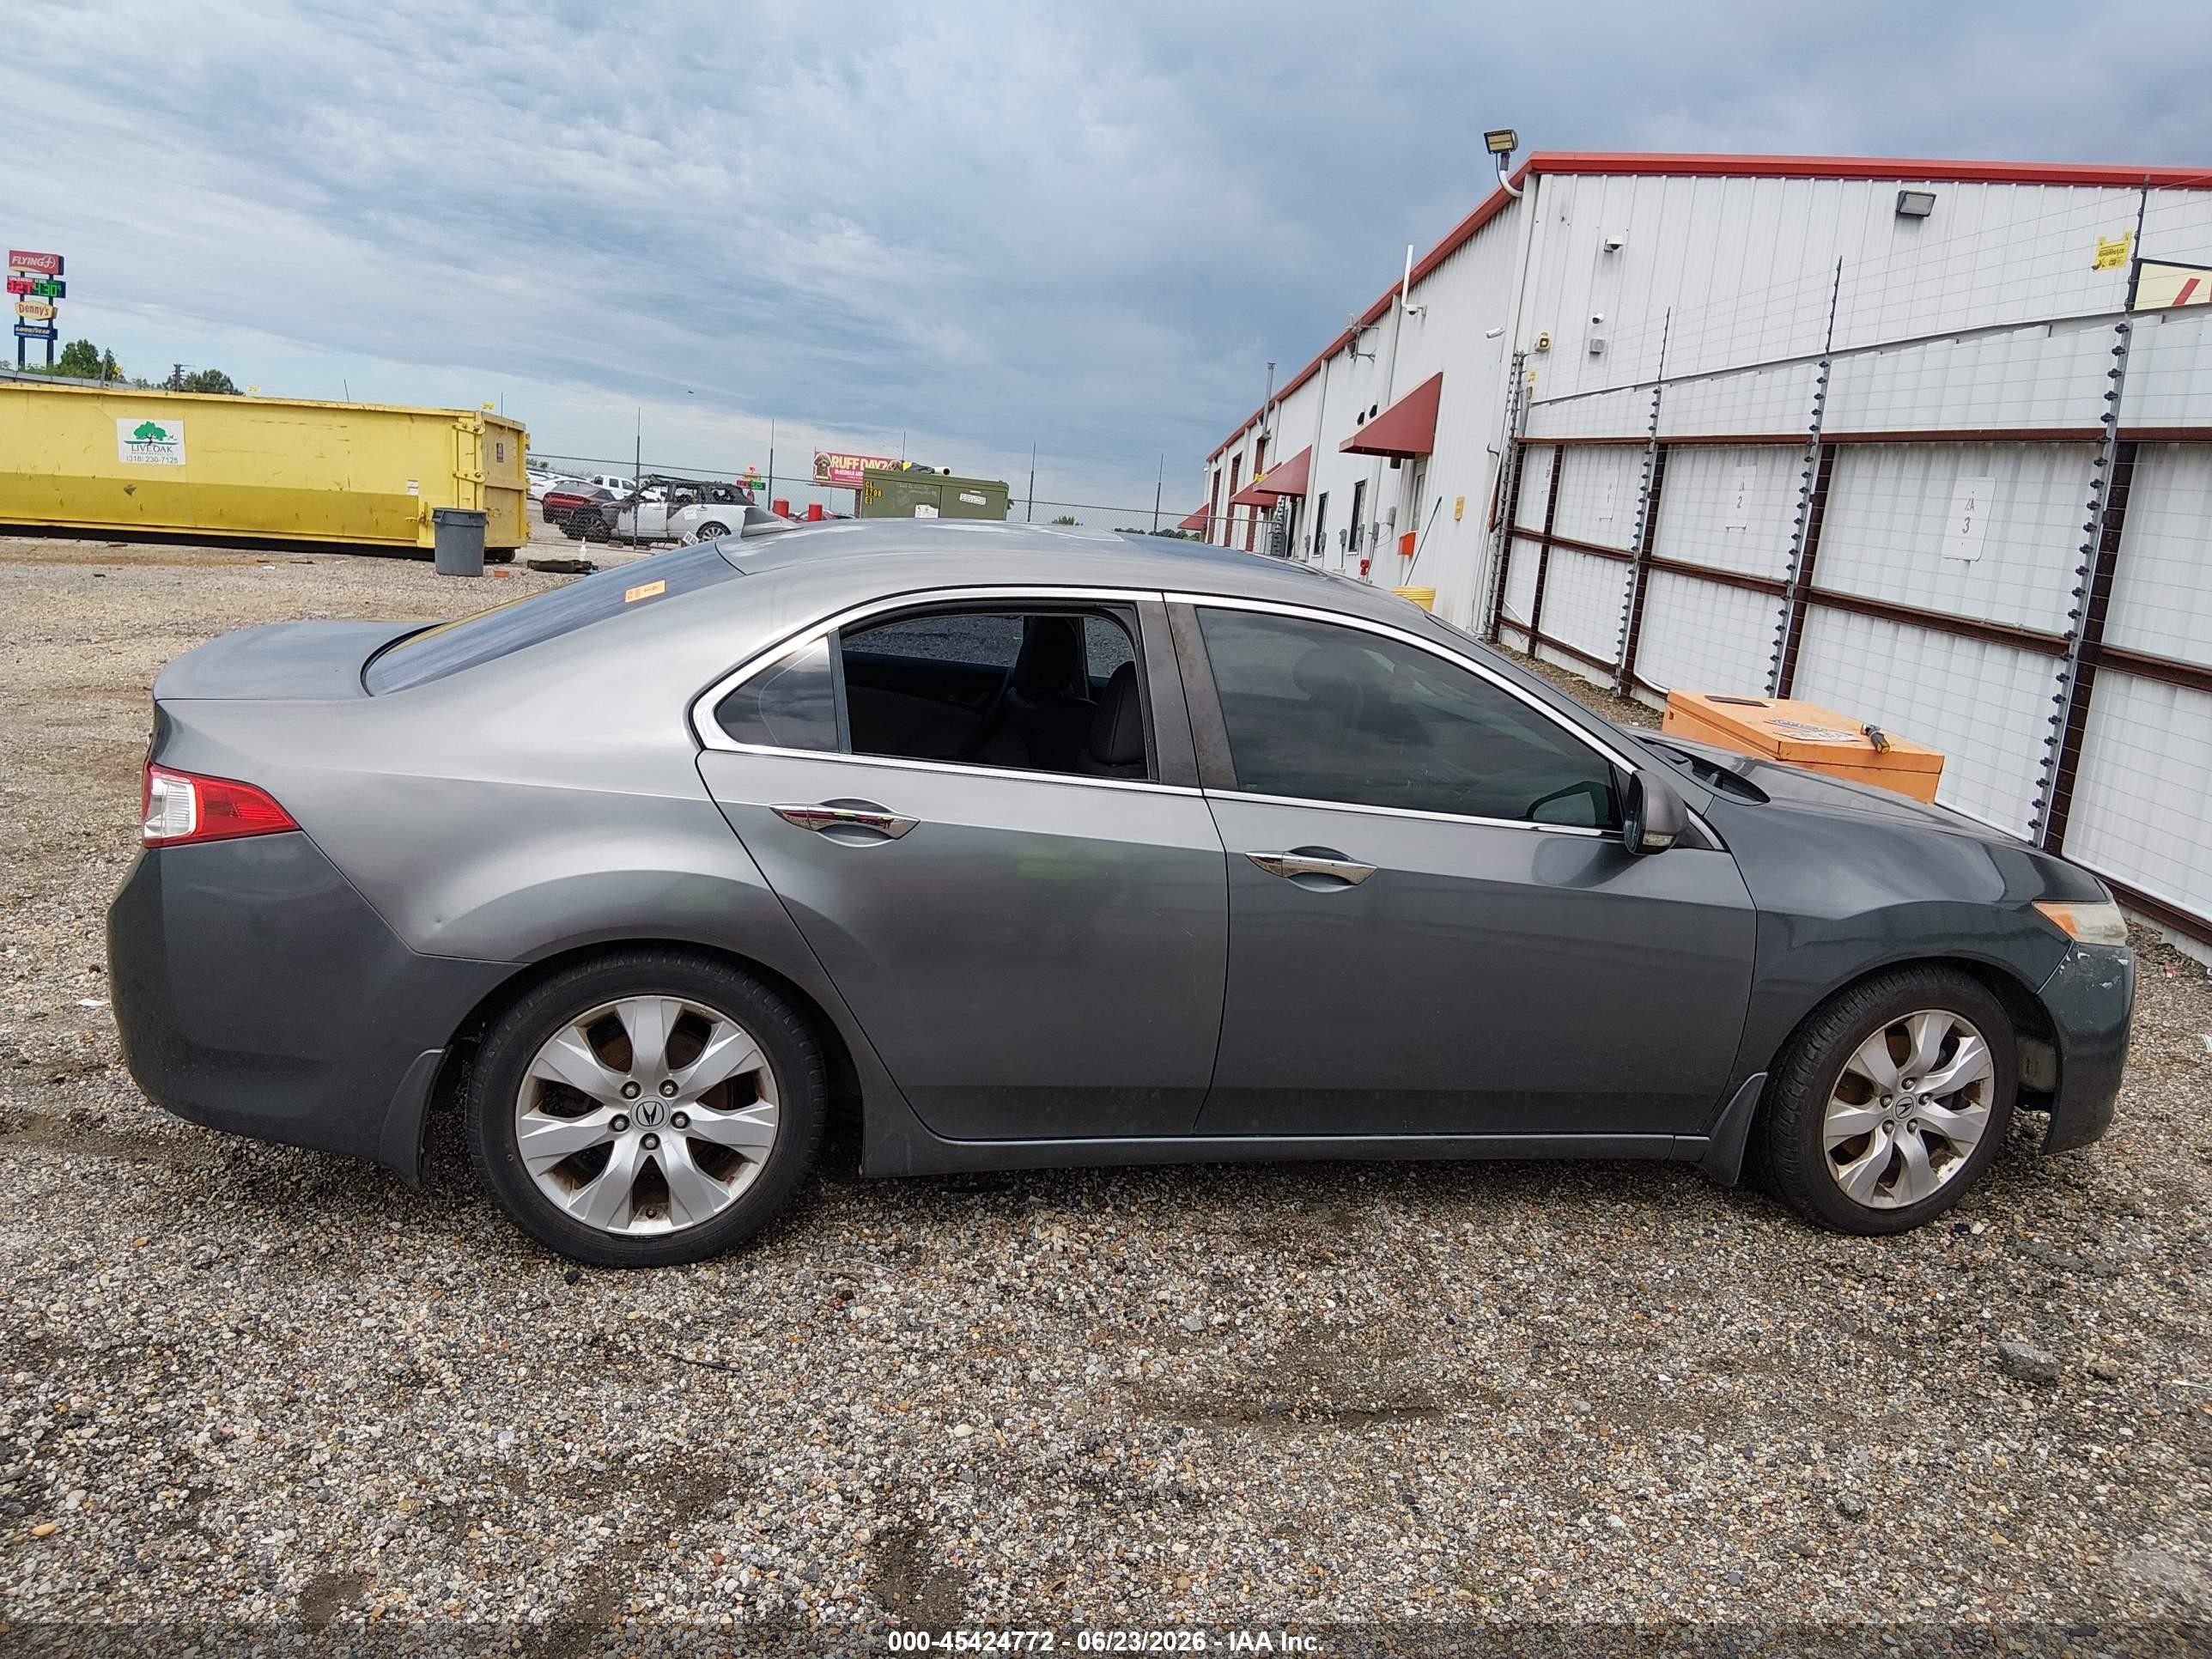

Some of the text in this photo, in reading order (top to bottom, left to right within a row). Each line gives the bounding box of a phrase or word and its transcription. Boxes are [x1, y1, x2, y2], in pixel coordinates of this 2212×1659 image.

[11, 256, 44, 267] FLYING
[18, 303, 51, 317] Denny's
[831, 455, 859, 470] RUFF
[1736, 495, 1743, 509] 2
[1961, 516, 1972, 534] 3
